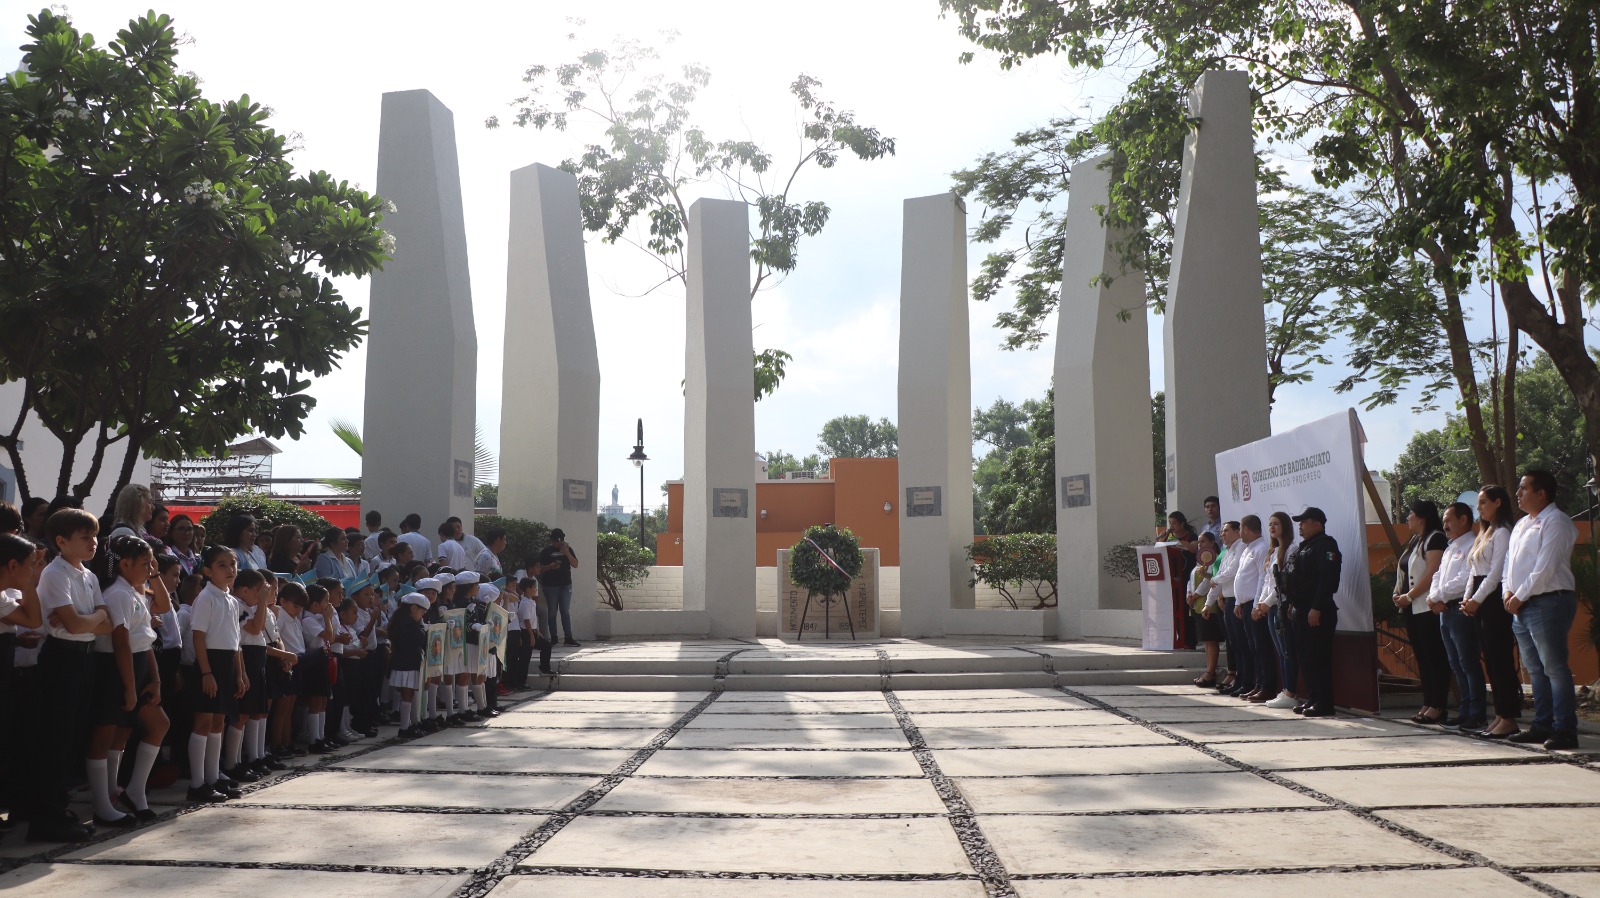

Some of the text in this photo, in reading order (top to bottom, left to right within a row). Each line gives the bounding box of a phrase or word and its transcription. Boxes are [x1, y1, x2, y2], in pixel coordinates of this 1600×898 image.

[1252, 450, 1331, 483] GOBIERNO DE BADIRAGUATO
[1260, 470, 1322, 492] GENERANDO PROGRESO
